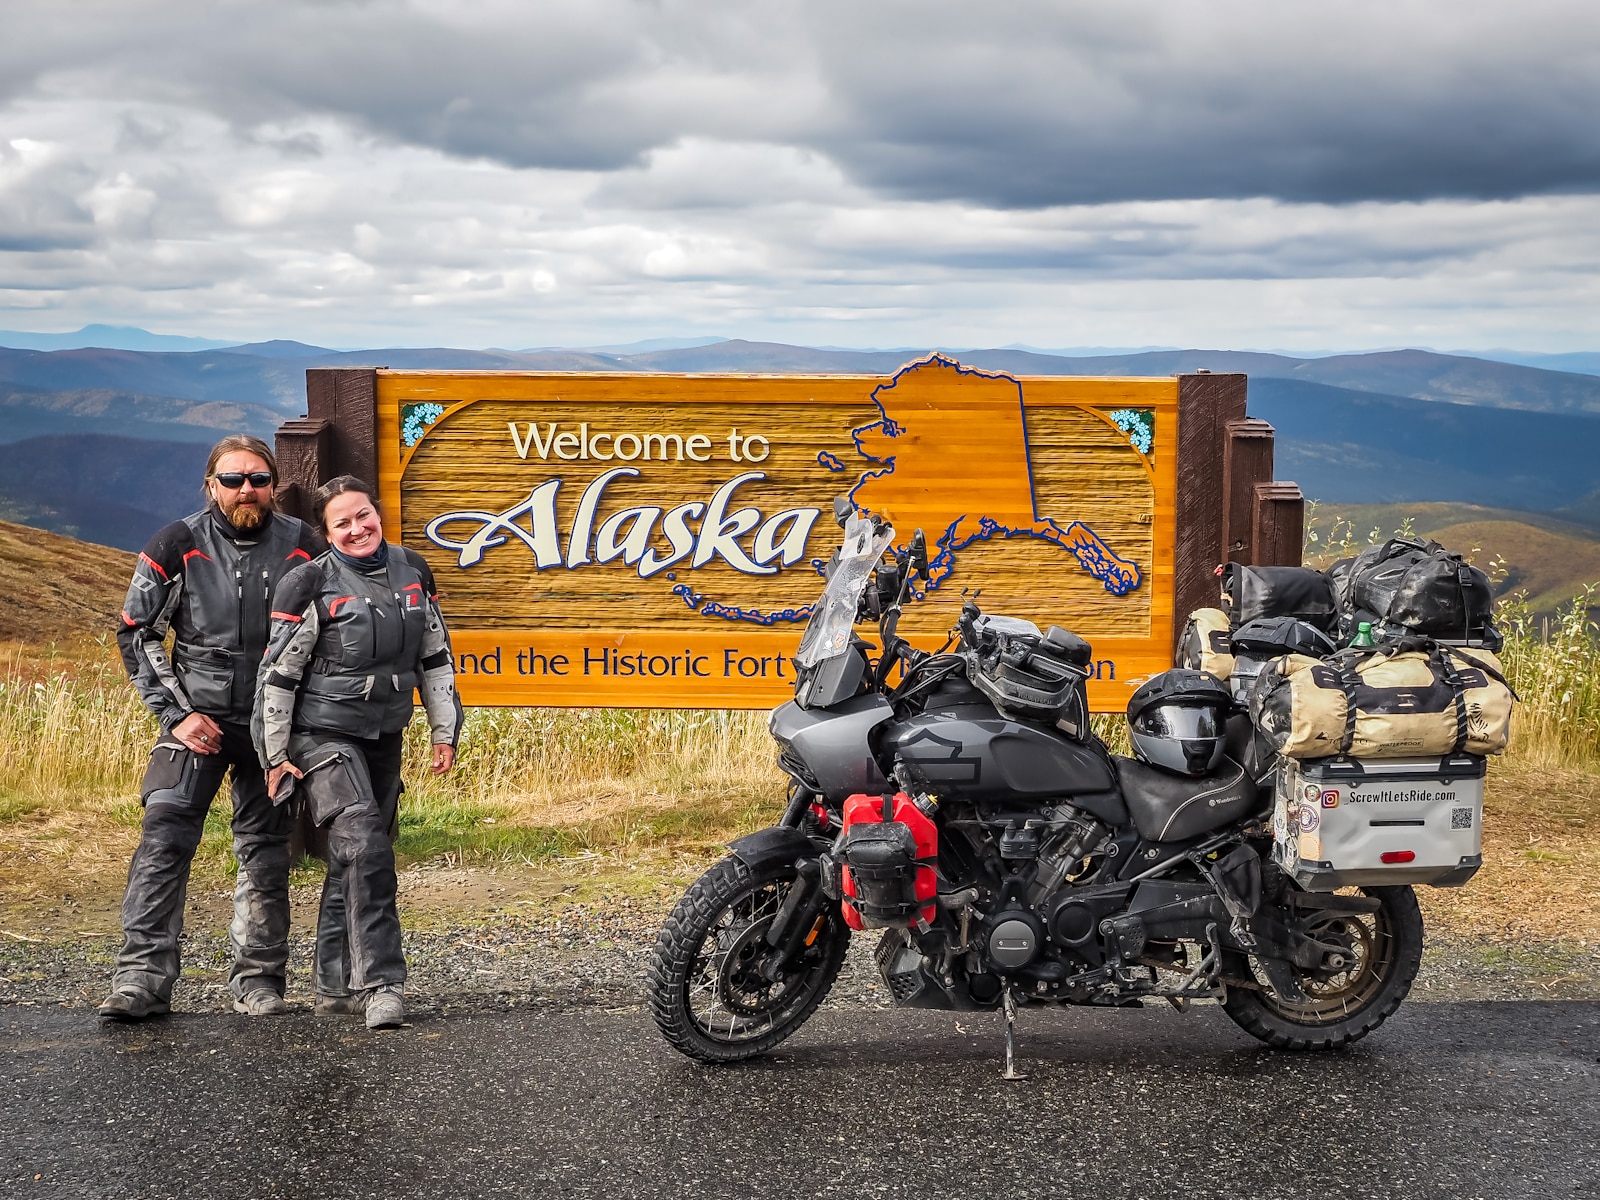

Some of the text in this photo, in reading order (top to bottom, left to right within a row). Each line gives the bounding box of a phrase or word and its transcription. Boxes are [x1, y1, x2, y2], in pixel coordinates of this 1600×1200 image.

[507, 422, 770, 462] Welcome to
[425, 467, 821, 578] Alaska
[516, 646, 570, 676] the
[583, 647, 711, 677] Historic
